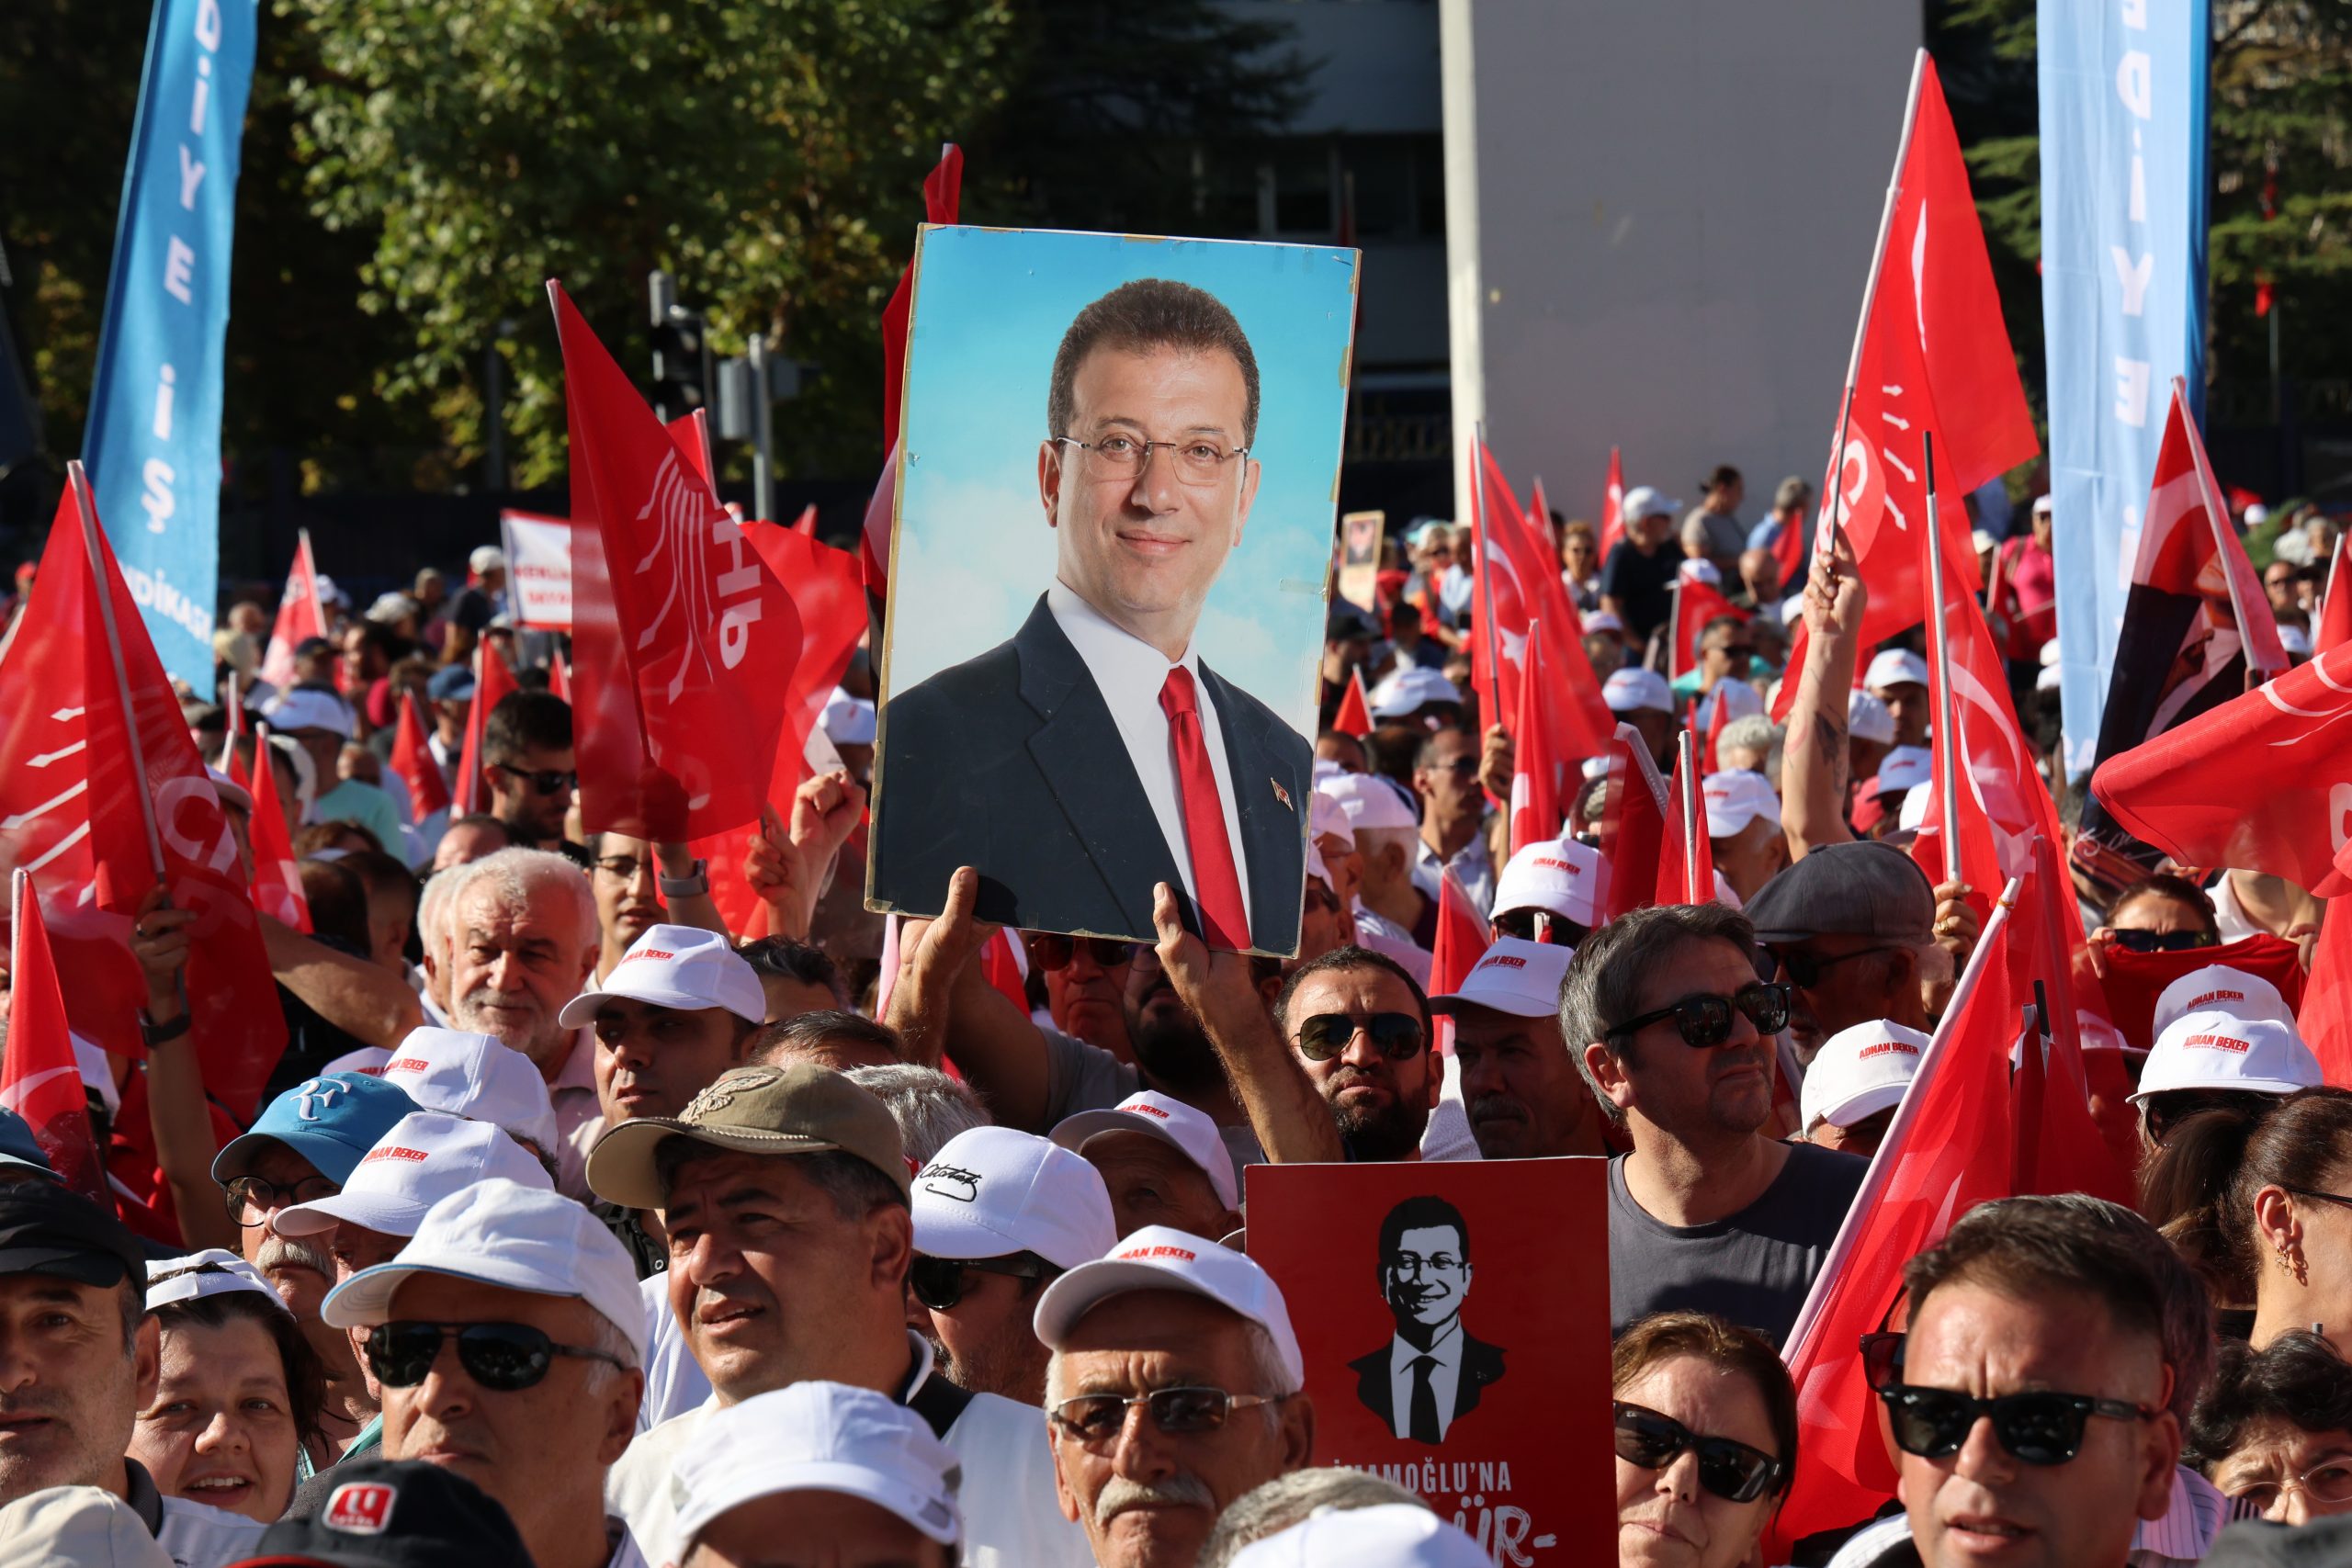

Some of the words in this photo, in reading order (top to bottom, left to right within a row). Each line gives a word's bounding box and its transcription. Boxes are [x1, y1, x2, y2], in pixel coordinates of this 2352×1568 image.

[141, 363, 175, 534] İŞ
[644, 949, 674, 960] BEKER
[1498, 955, 1527, 967] BEKER
[2187, 991, 2215, 1011] ADNAN
[2216, 989, 2245, 1001] BEKER
[1859, 1042, 1891, 1059] ADNAN
[1891, 1042, 1919, 1055] BEKER
[2182, 1034, 2216, 1047] ADNAN
[2215, 1035, 2250, 1053] BEKER
[1138, 1104, 1170, 1118] BEKER
[391, 1146, 429, 1161] BEKER
[1151, 1245, 1197, 1262] BEKER
